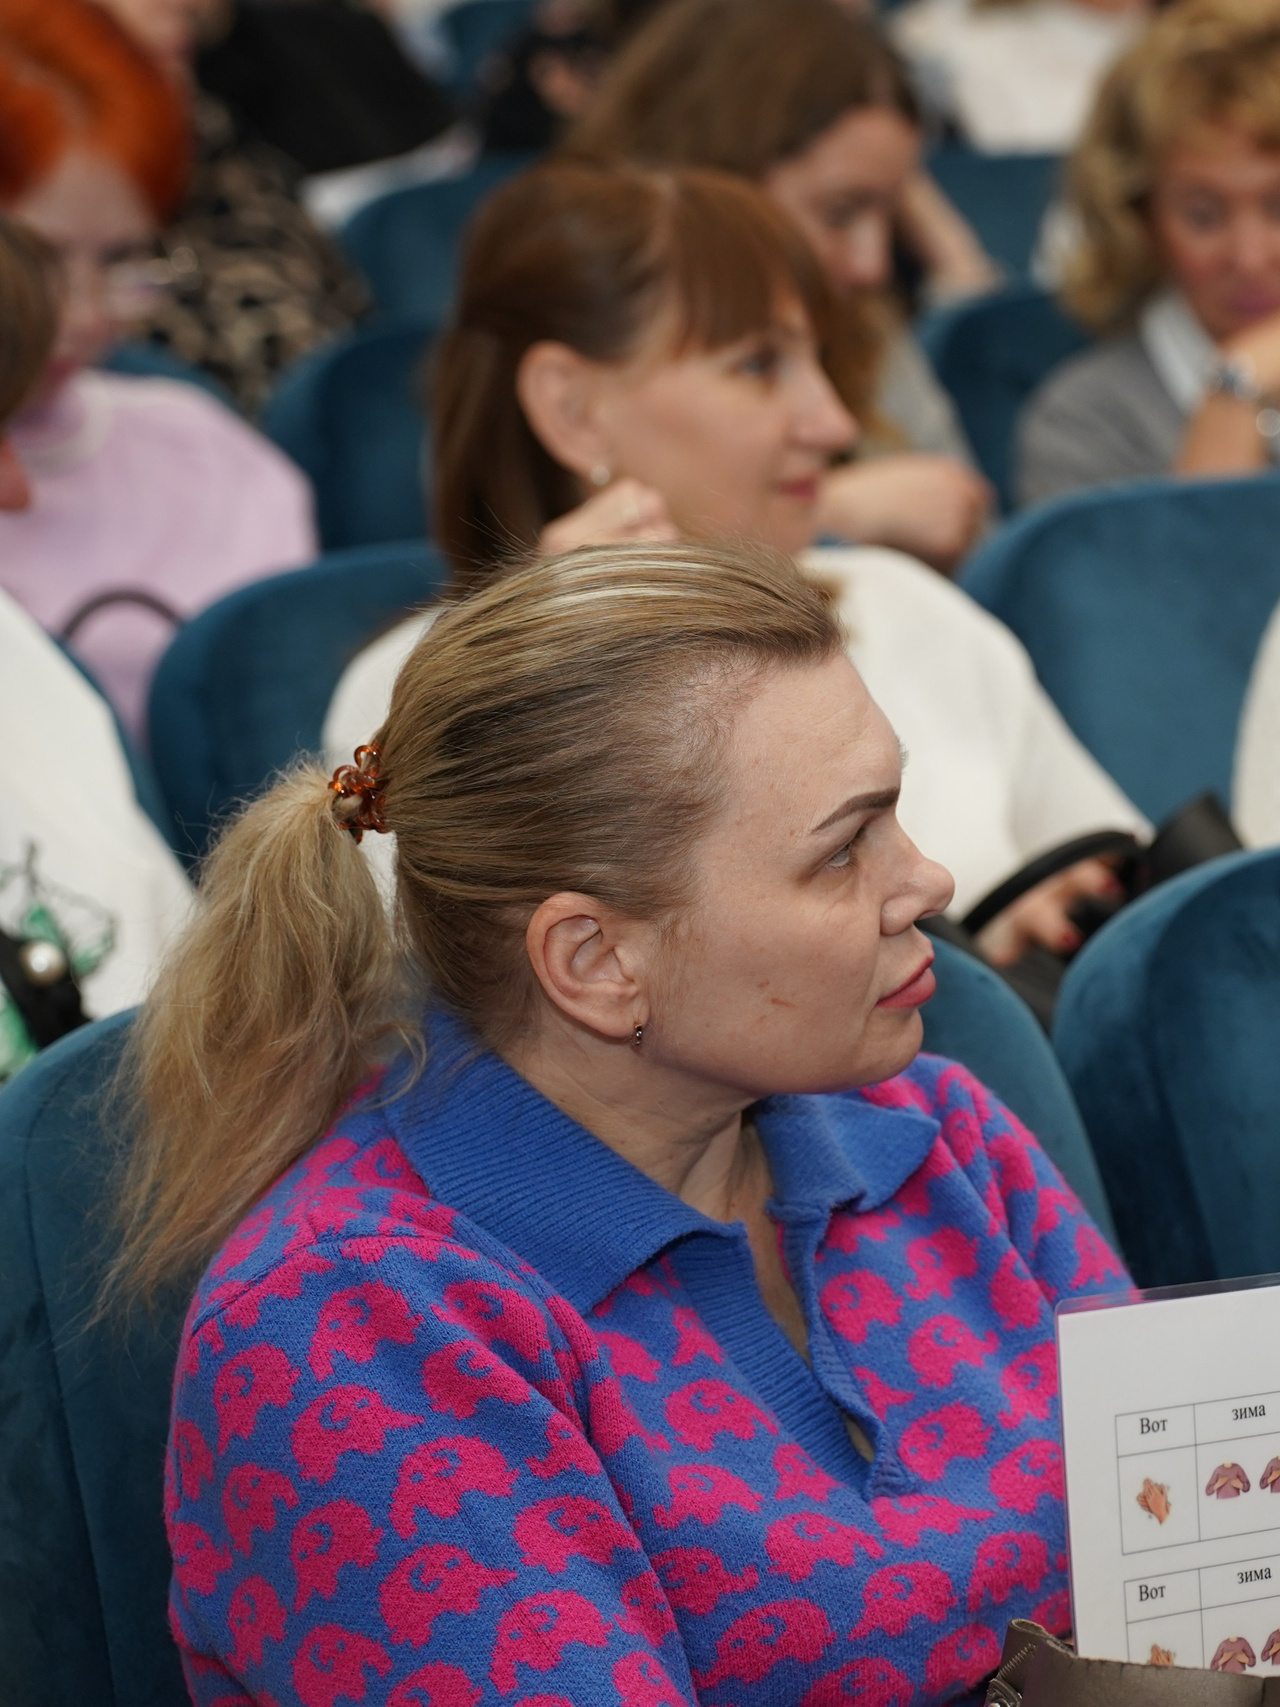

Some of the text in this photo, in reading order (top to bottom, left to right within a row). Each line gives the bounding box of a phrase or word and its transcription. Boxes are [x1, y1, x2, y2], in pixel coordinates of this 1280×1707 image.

[1140, 1417, 1168, 1435] Вот
[1231, 1404, 1266, 1421] зима
[1138, 1584, 1166, 1602] Вот
[1237, 1567, 1272, 1584] зима
